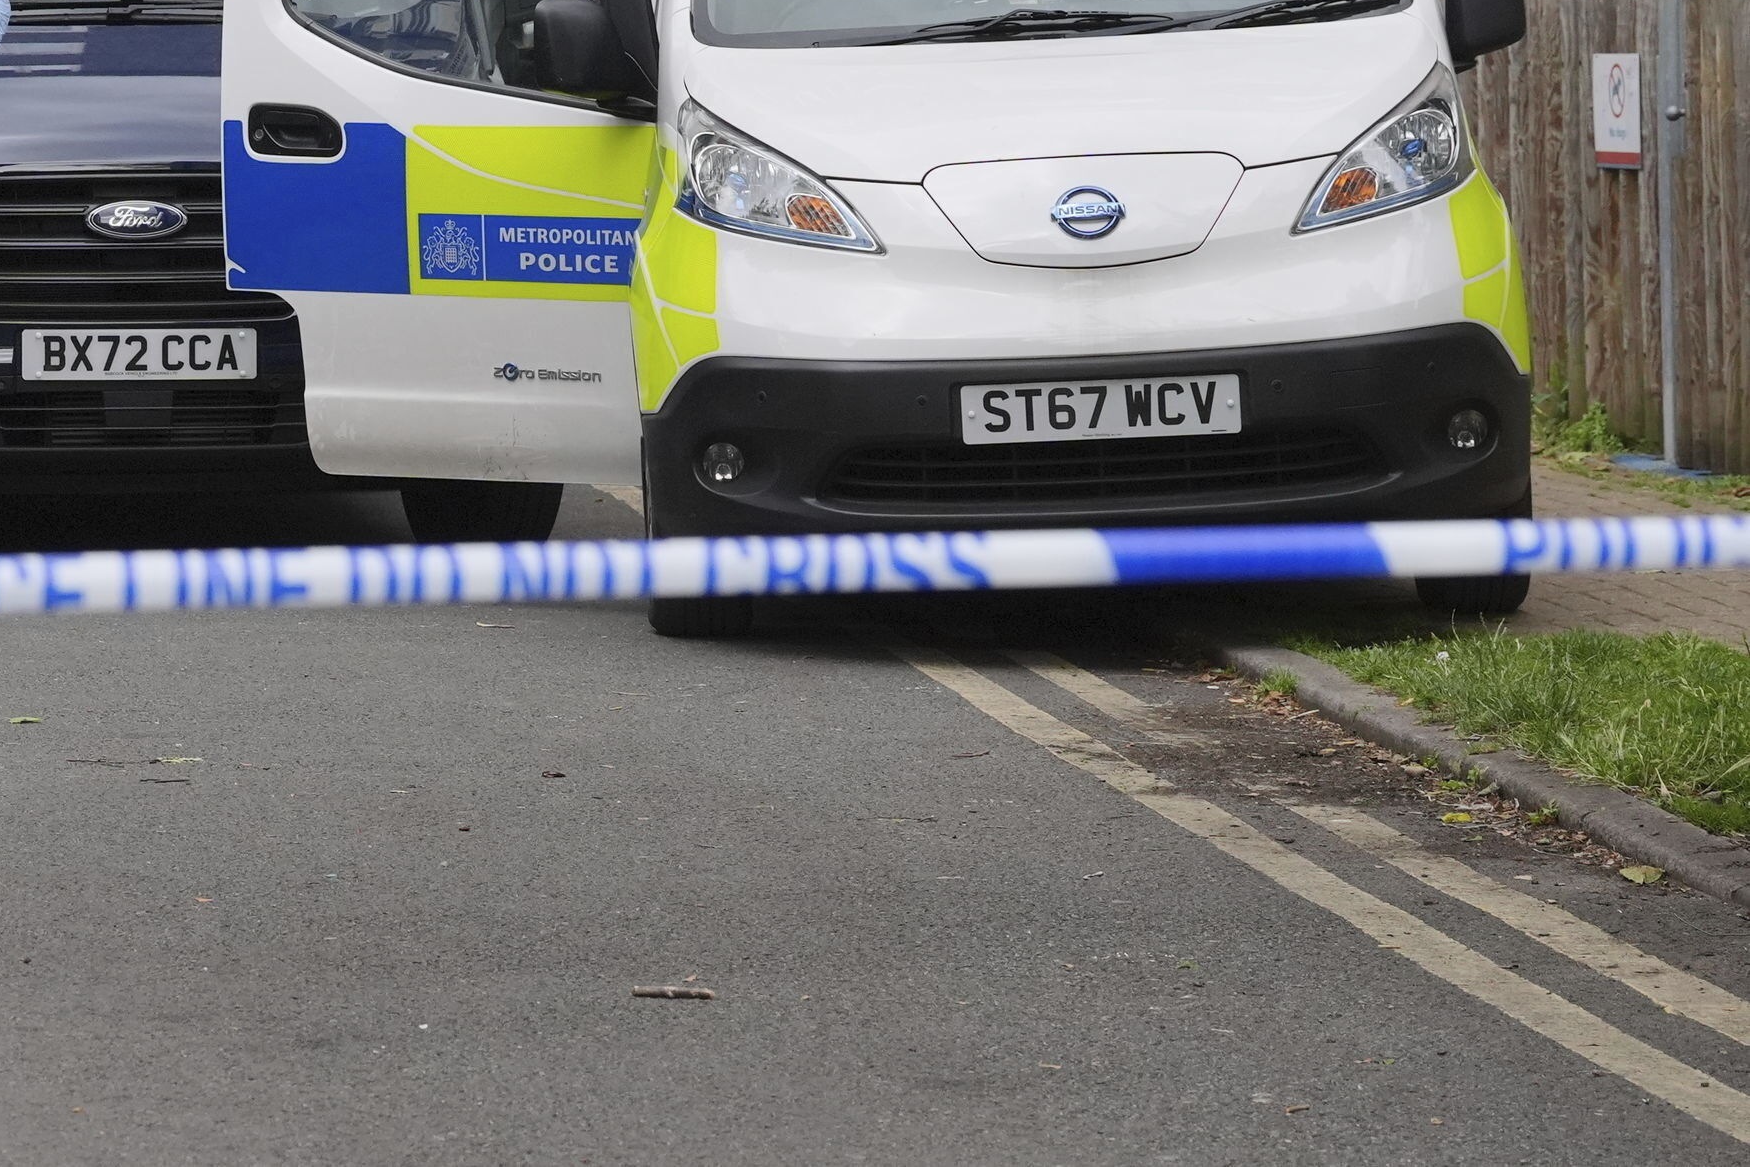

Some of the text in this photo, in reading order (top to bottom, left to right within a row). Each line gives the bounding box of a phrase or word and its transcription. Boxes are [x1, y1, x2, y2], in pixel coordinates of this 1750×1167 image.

[108, 206, 164, 228] Ford
[1058, 204, 1118, 215] NISSAN
[519, 252, 619, 273] POLICE
[43, 334, 239, 371] BX72 CCA
[982, 381, 1217, 433] ST67 WCV
